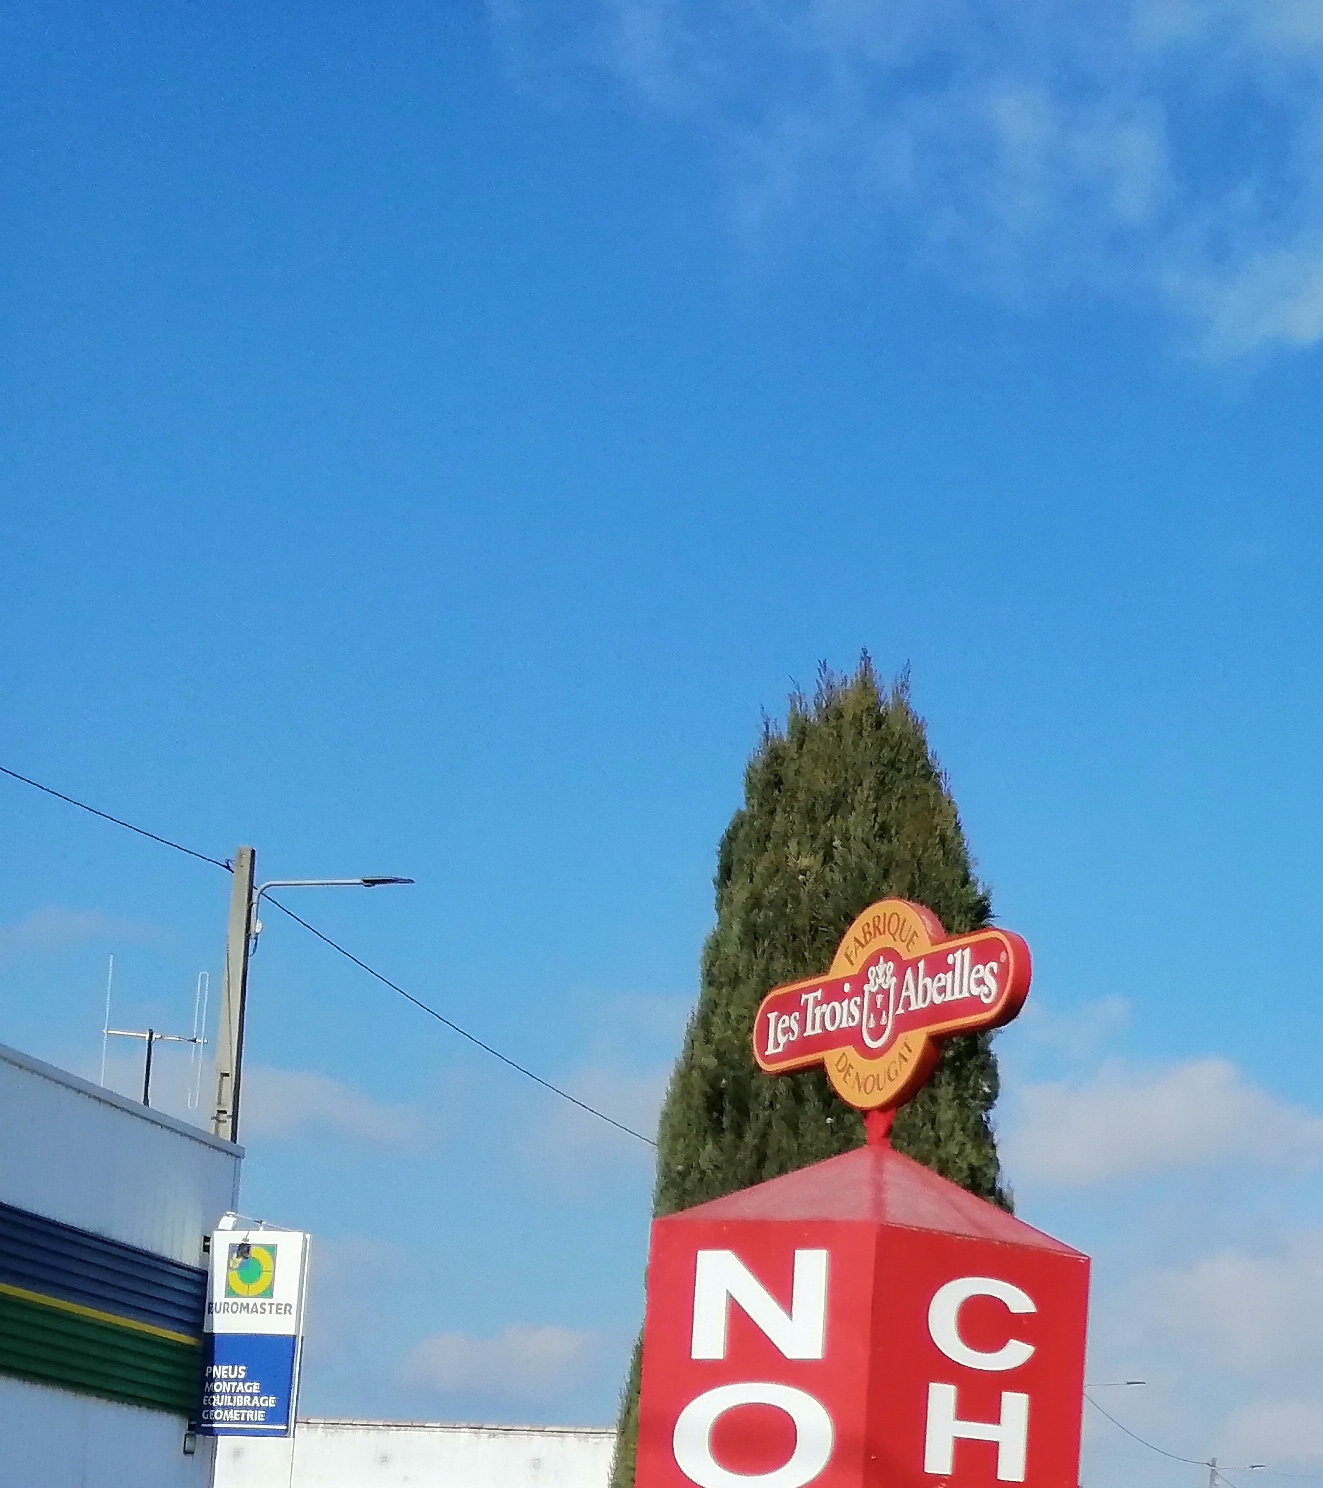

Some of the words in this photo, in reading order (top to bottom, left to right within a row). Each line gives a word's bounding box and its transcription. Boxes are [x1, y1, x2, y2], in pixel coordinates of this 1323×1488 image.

[843, 911, 920, 967] FABRIQUE
[765, 1011, 800, 1056] Les
[801, 983, 861, 1037] Trois
[895, 946, 998, 1016] Abeilles
[835, 1052, 852, 1084] DE
[852, 1037, 914, 1095] NOUGAT
[207, 1301, 293, 1316] EUROMASTER
[204, 1381, 261, 1394] MONTAGE
[205, 1365, 247, 1379] PNEUS
